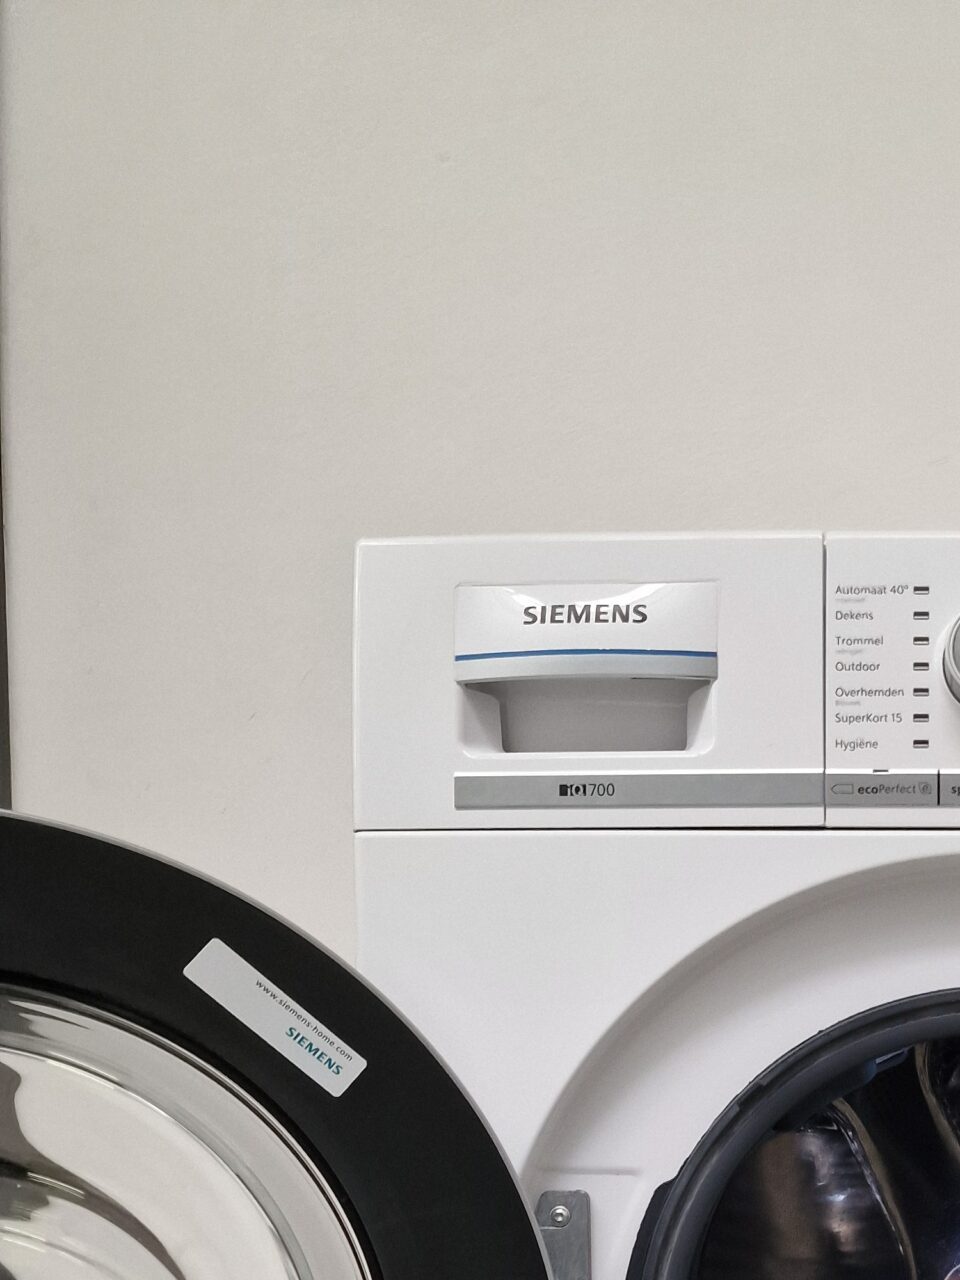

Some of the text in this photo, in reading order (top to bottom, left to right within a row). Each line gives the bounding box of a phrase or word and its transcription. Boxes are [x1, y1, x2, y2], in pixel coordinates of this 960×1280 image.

[835, 585, 886, 595] Automaat
[523, 604, 648, 625] SIEMENS
[835, 610, 874, 620] Dekens
[835, 636, 884, 646] Trommel
[835, 661, 880, 671] Outdoor
[835, 687, 905, 697] Overhemden
[835, 712, 903, 725] SuperKort 15
[835, 738, 879, 751] Hygiëne
[857, 783, 916, 795] ecoPerfect
[255, 978, 353, 1062] www.siemens-home.com
[285, 1026, 343, 1076] SIEMENS
